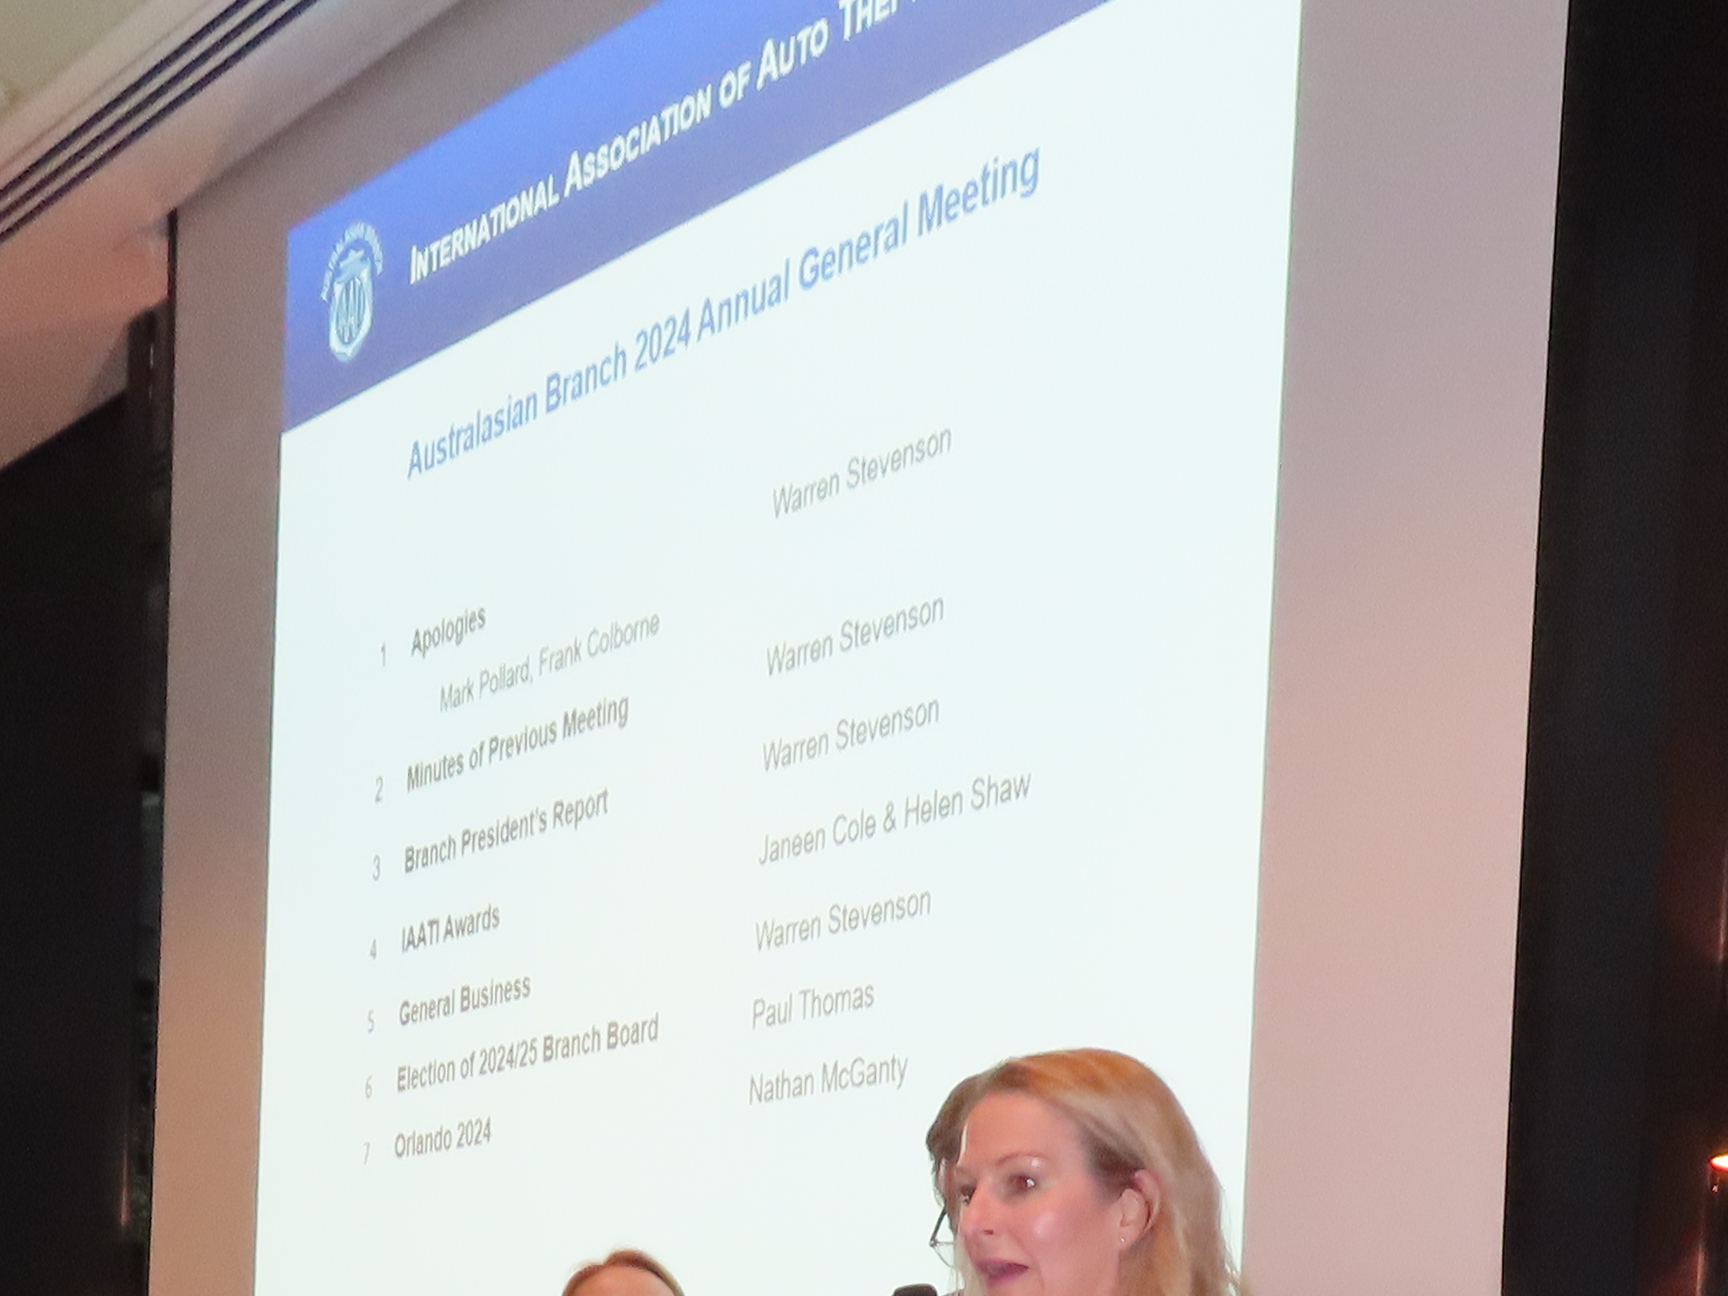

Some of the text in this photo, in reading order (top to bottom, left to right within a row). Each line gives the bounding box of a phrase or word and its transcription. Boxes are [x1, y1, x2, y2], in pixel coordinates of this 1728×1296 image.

[410, 176, 560, 285] INTERNATIONAL
[564, 84, 712, 199] ASSOCIATION
[719, 60, 752, 109] OF
[756, 18, 830, 90] AUTO
[838, 0, 917, 42] THE
[407, 147, 1040, 480] Australasian Branch 2024 Annual General Meeting
[772, 426, 952, 518] Warren Stevenson
[379, 606, 486, 669] 1 Apologies
[439, 610, 661, 713] Mark Pollard, Frank Colborne
[766, 597, 945, 676] Warren Stevenson
[374, 695, 630, 803] 2 Minutes of Previous Meeting
[762, 698, 941, 773] Warren Stevenson
[372, 788, 610, 882] 3 Branch President's Report
[758, 773, 1032, 867] Janeen Cole & Helen Shaw
[369, 904, 501, 962] 4 IAATI Awards
[756, 890, 932, 952] Warren Stevenson
[367, 976, 531, 1034] 5 General Business
[752, 982, 875, 1029] Paul Thomas
[364, 1012, 660, 1100] 6 Election of 2024/25 Branch Board
[749, 1069, 815, 1105] Nathan
[362, 1117, 492, 1166] 7 Orlando 2024
